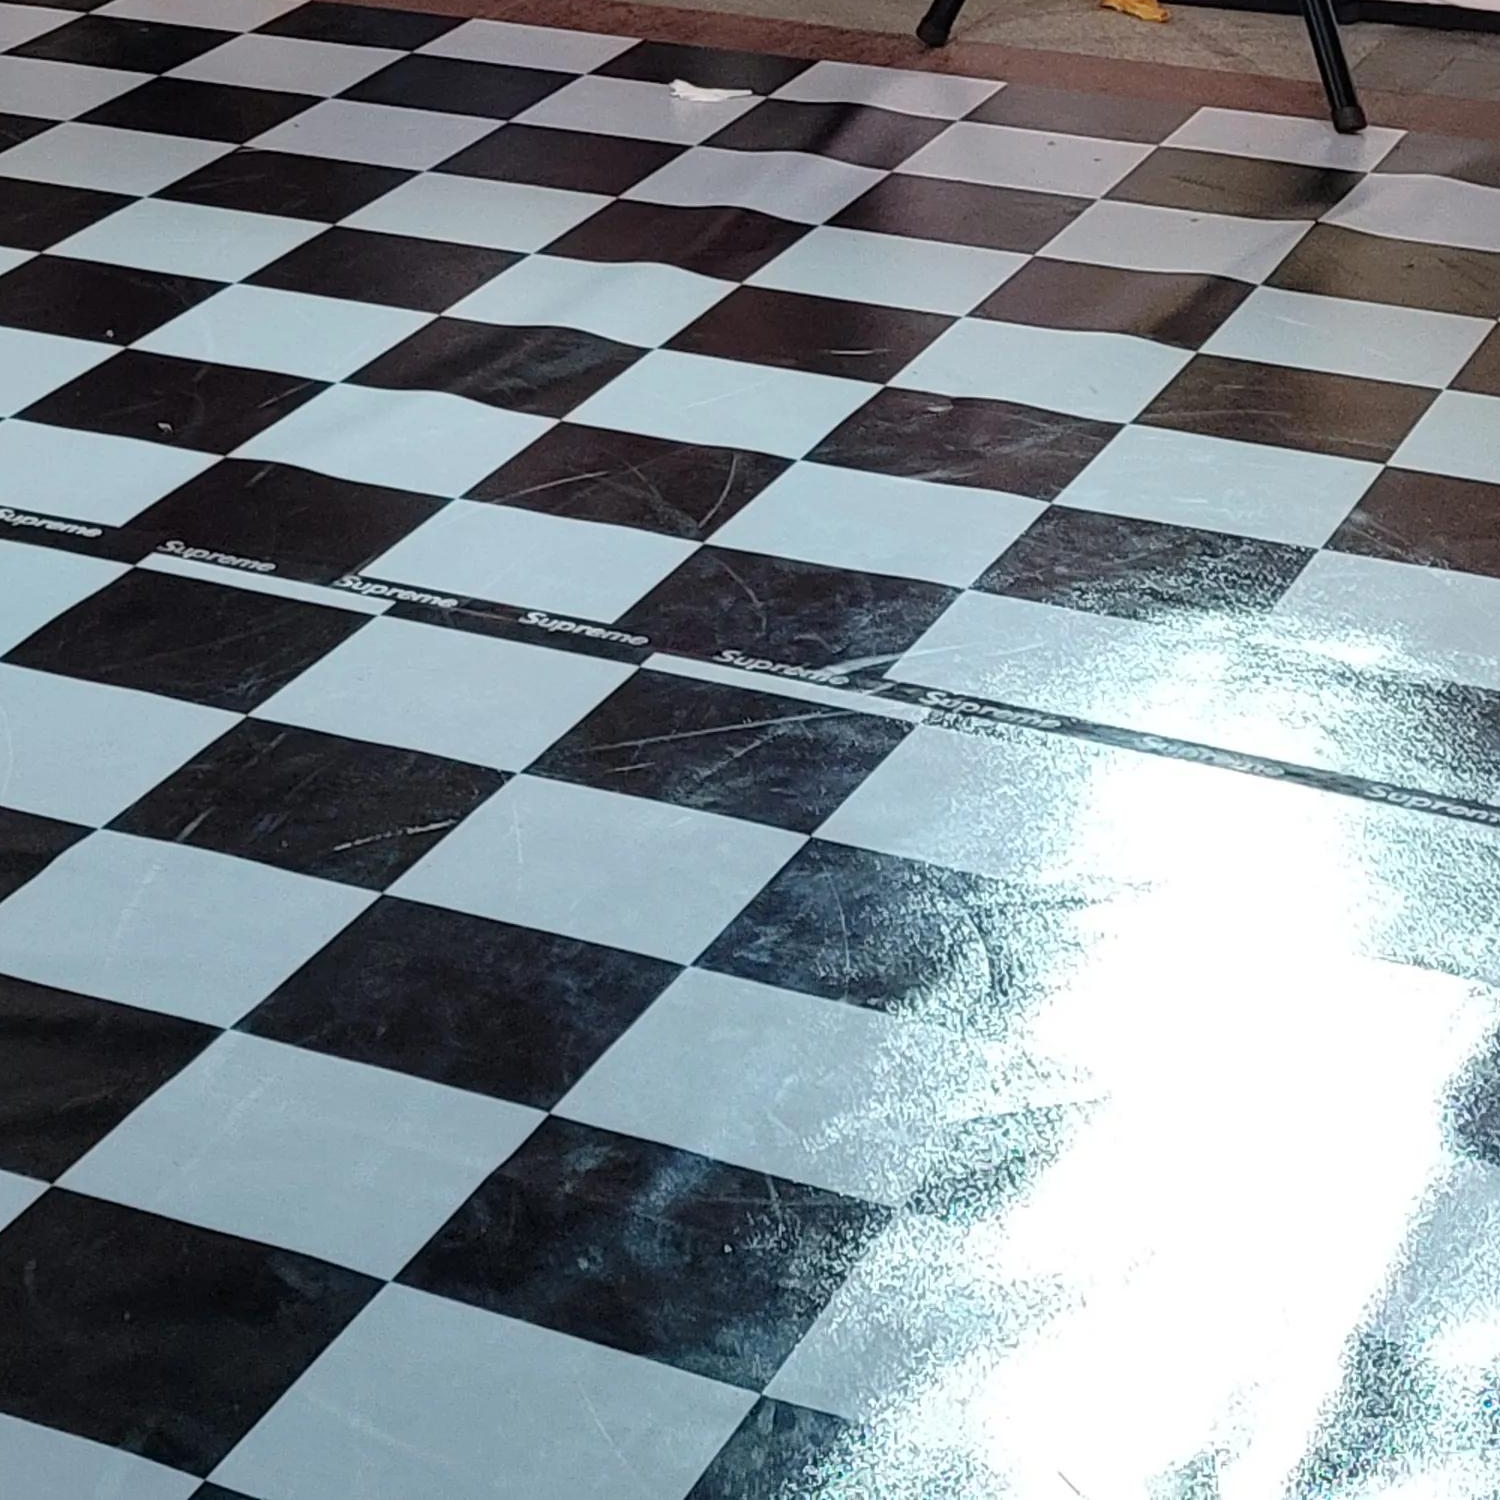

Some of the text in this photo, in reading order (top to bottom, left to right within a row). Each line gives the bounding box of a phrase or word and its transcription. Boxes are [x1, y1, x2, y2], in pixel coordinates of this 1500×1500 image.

[156, 539, 278, 573] Supreme
[332, 574, 460, 611] Supreme
[517, 611, 650, 648] Supreme
[713, 648, 851, 687] Supreme
[917, 690, 1064, 730] Supreme
